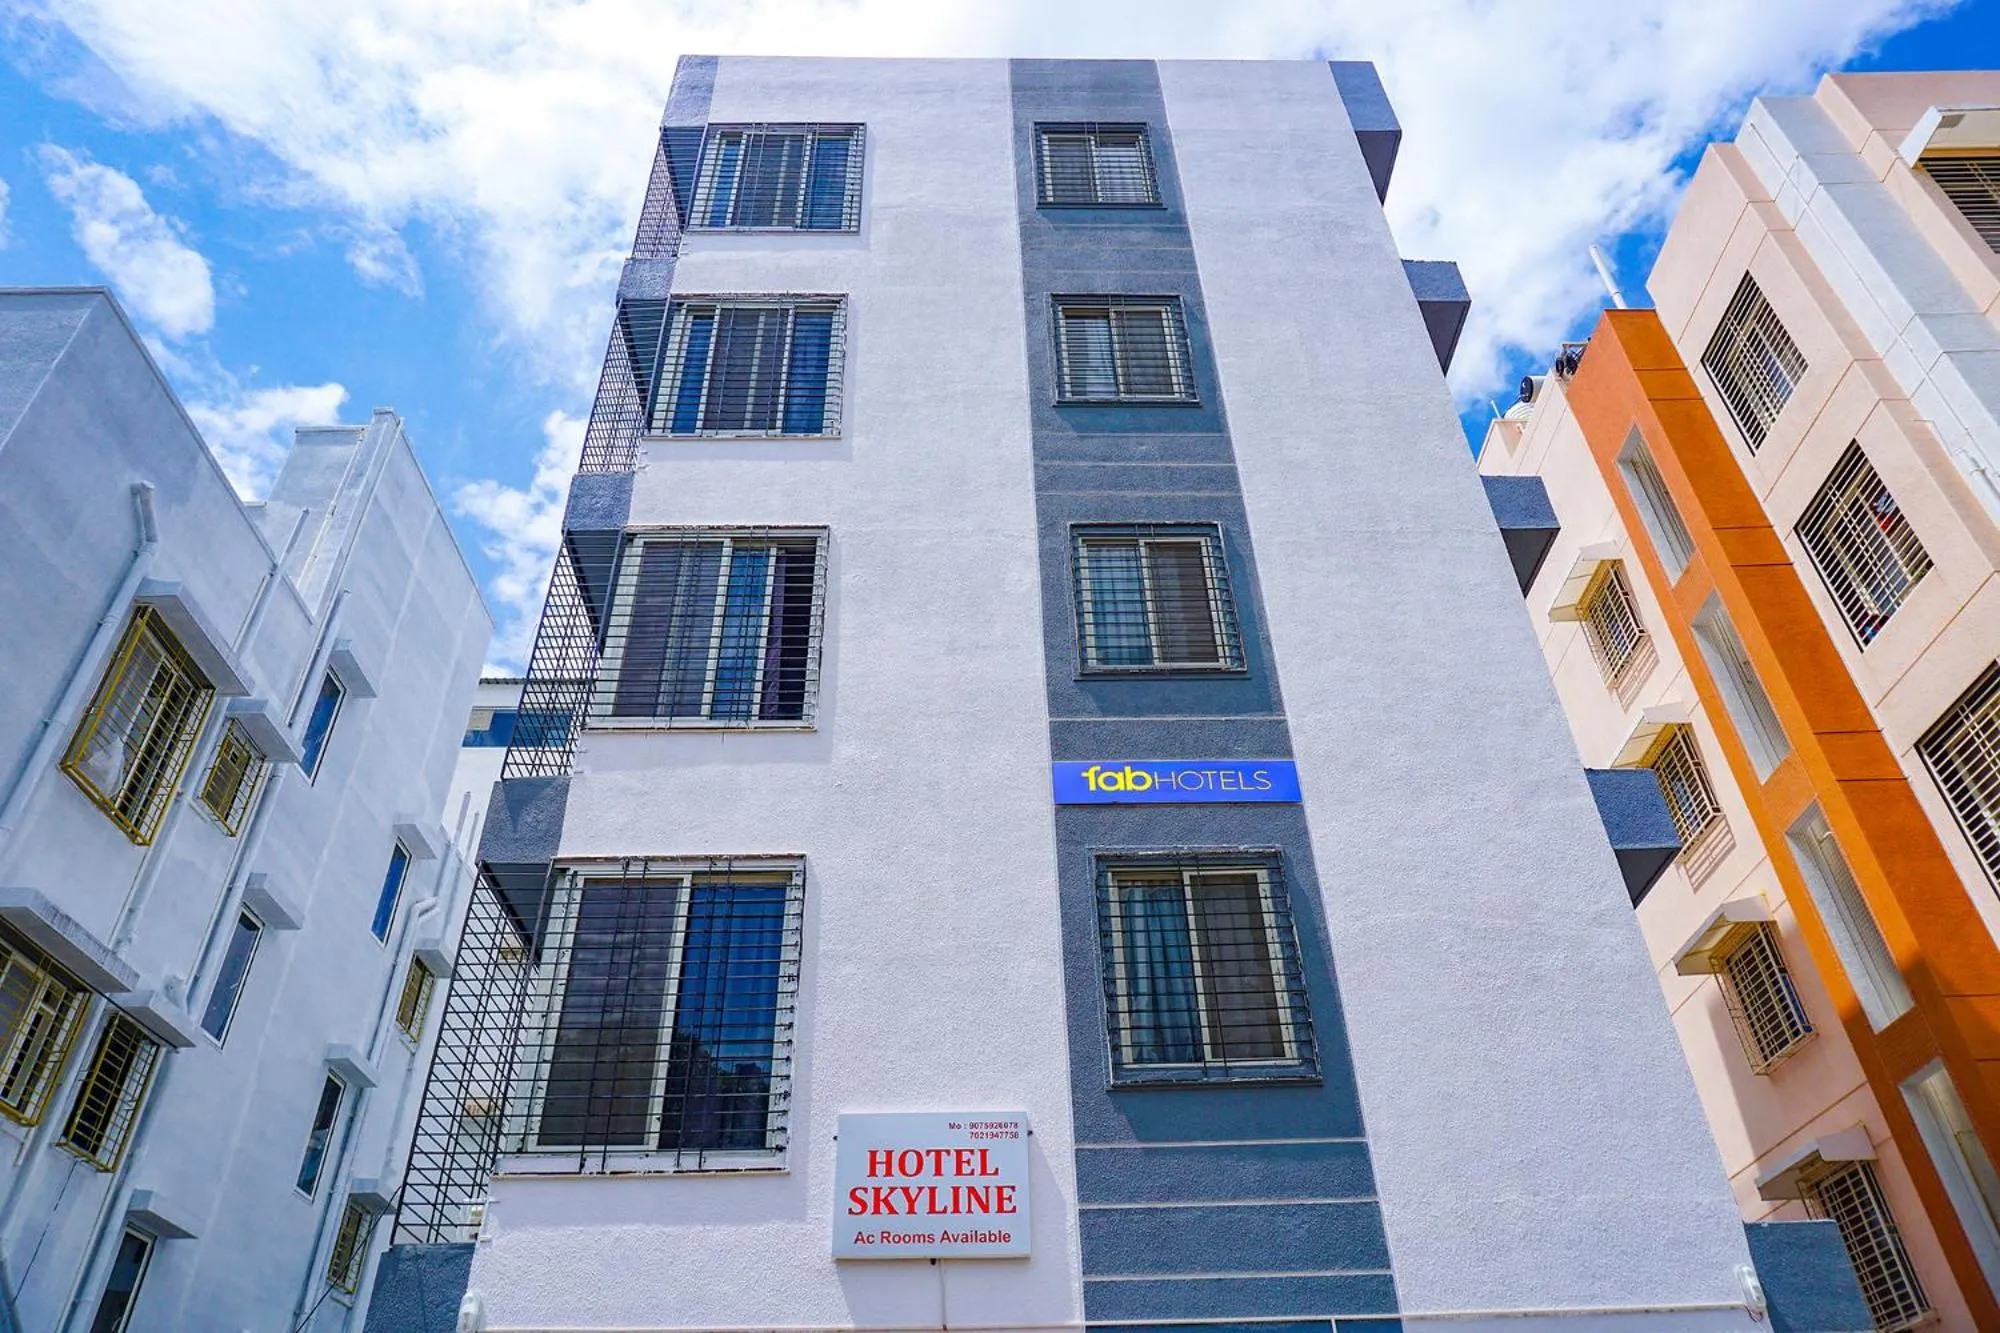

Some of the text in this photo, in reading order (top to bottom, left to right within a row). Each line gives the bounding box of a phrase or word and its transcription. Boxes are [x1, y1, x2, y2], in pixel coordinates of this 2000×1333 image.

[866, 1148, 1000, 1178] HOTEL
[848, 1185, 1017, 1216] SKYLINE
[854, 1229, 1012, 1245] Ac Rooms Available
